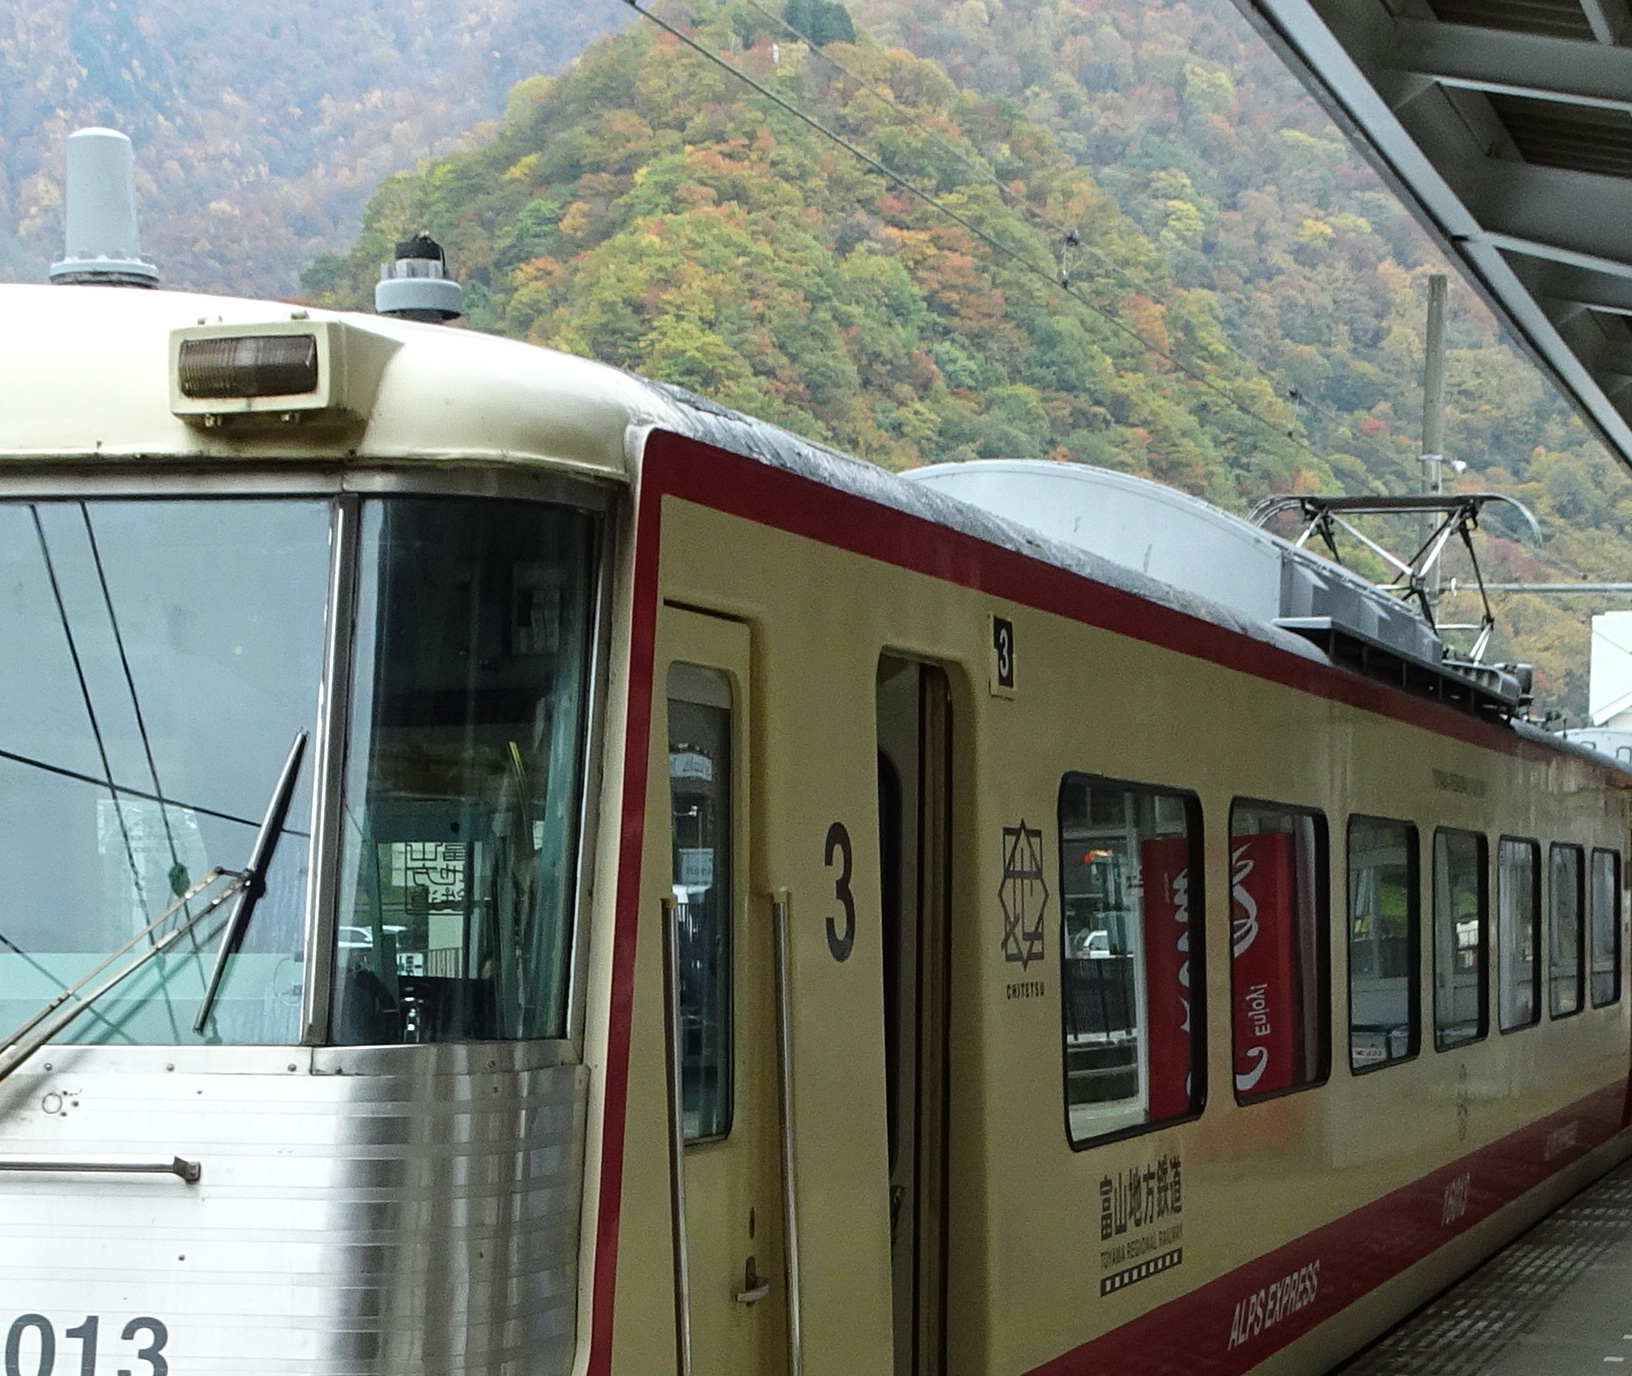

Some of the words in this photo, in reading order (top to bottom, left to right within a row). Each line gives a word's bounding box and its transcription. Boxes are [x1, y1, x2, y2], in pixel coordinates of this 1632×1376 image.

[997, 628, 1011, 679] 3
[824, 821, 857, 963] 3
[1006, 981, 1045, 1000] CHITETSU
[1227, 1288, 1265, 1350] ALPS
[1264, 1259, 1320, 1329] EXPRESS
